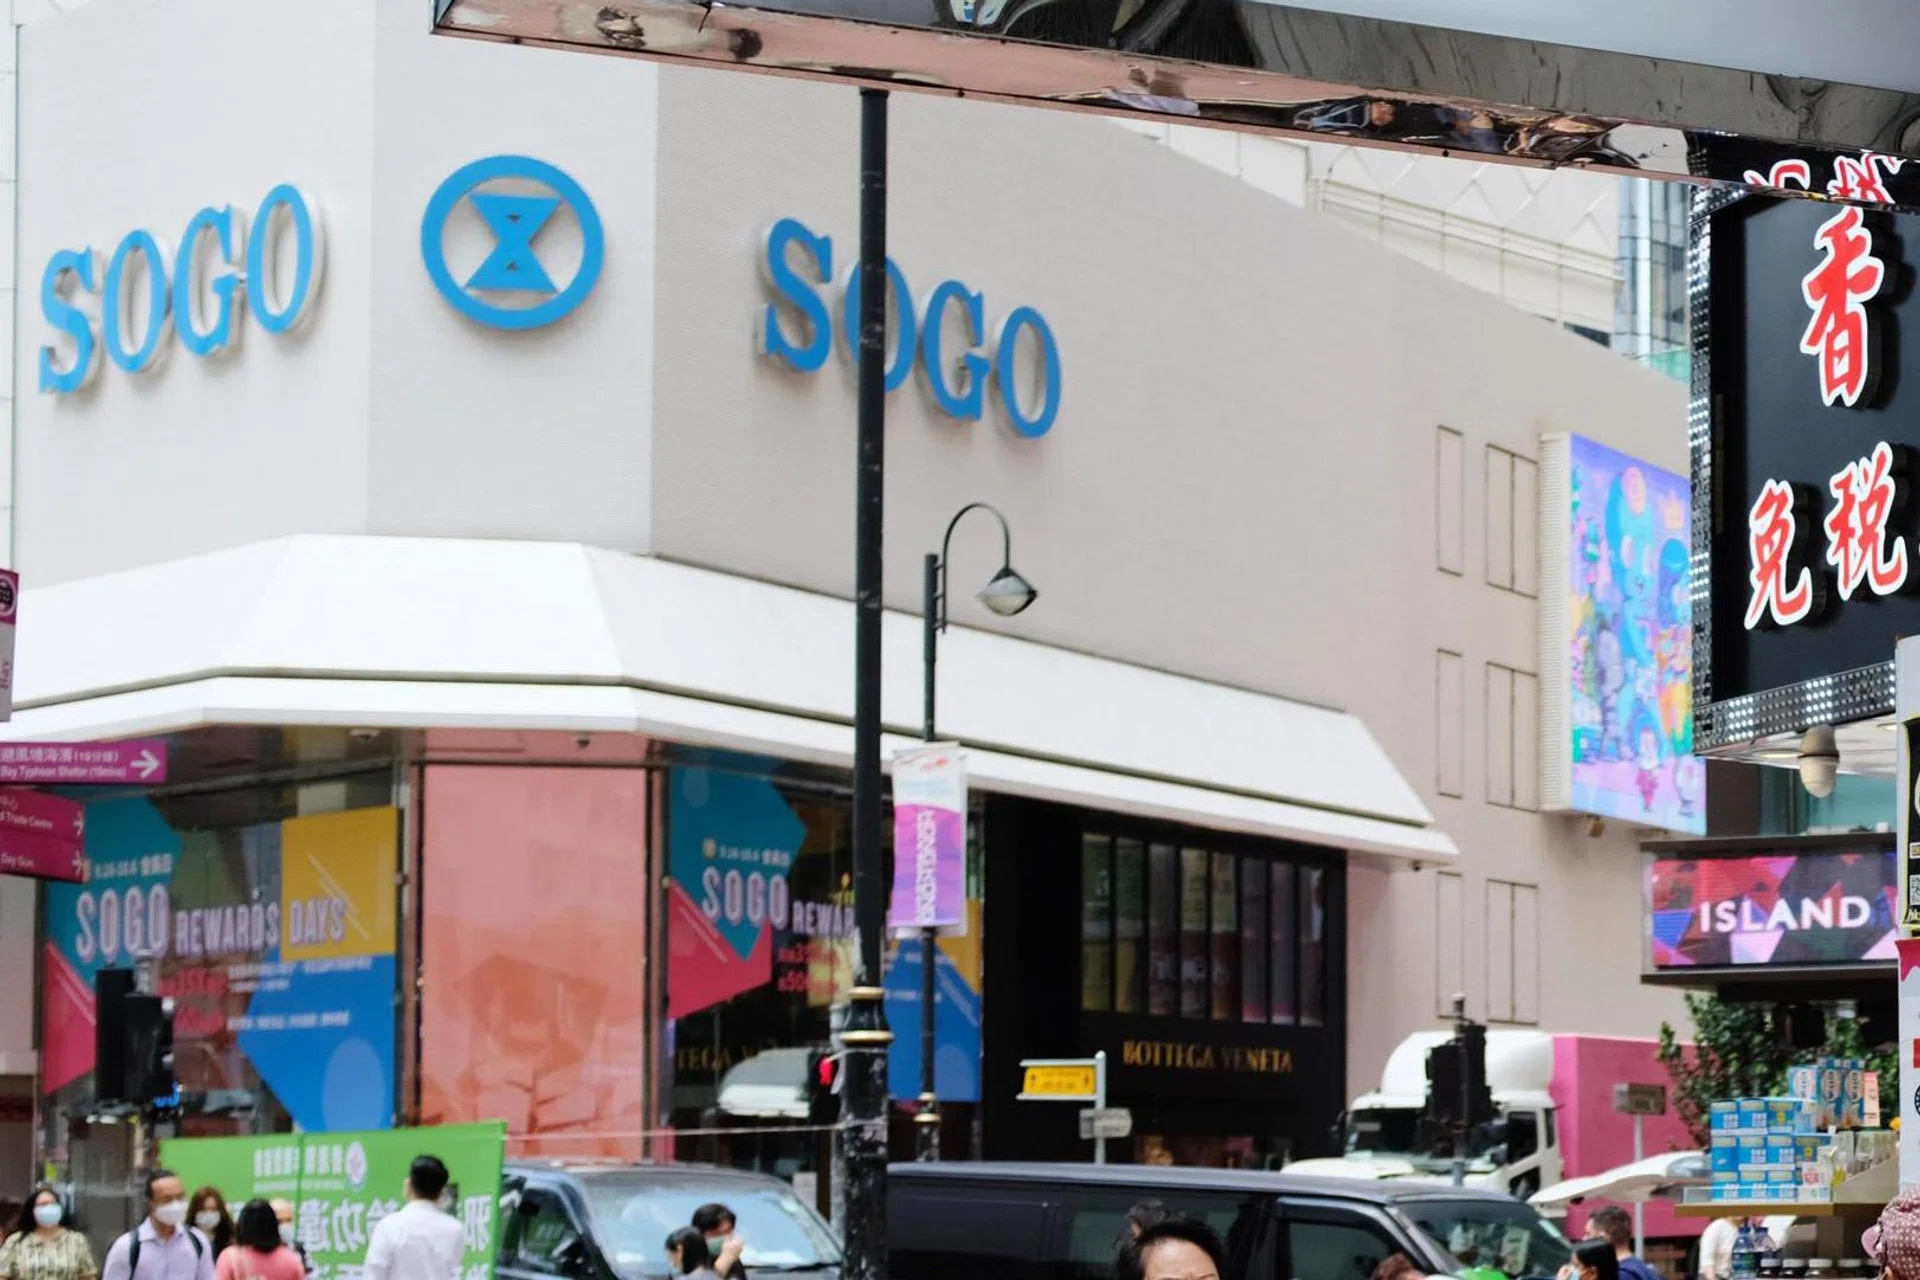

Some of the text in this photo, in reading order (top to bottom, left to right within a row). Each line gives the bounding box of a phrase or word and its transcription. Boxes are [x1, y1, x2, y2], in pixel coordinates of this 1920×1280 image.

[39, 184, 313, 394] SOGO
[1800, 205, 1884, 407] 香
[764, 217, 1062, 439] SOGO
[18, 765, 56, 778] Typhoon
[58, 765, 87, 777] Shelter
[76, 883, 346, 963] SOGO REWARDS DAYS
[702, 866, 789, 930] SOGO
[1700, 896, 1871, 933] ISLAND
[1122, 1040, 1214, 1069] BOTTEGA
